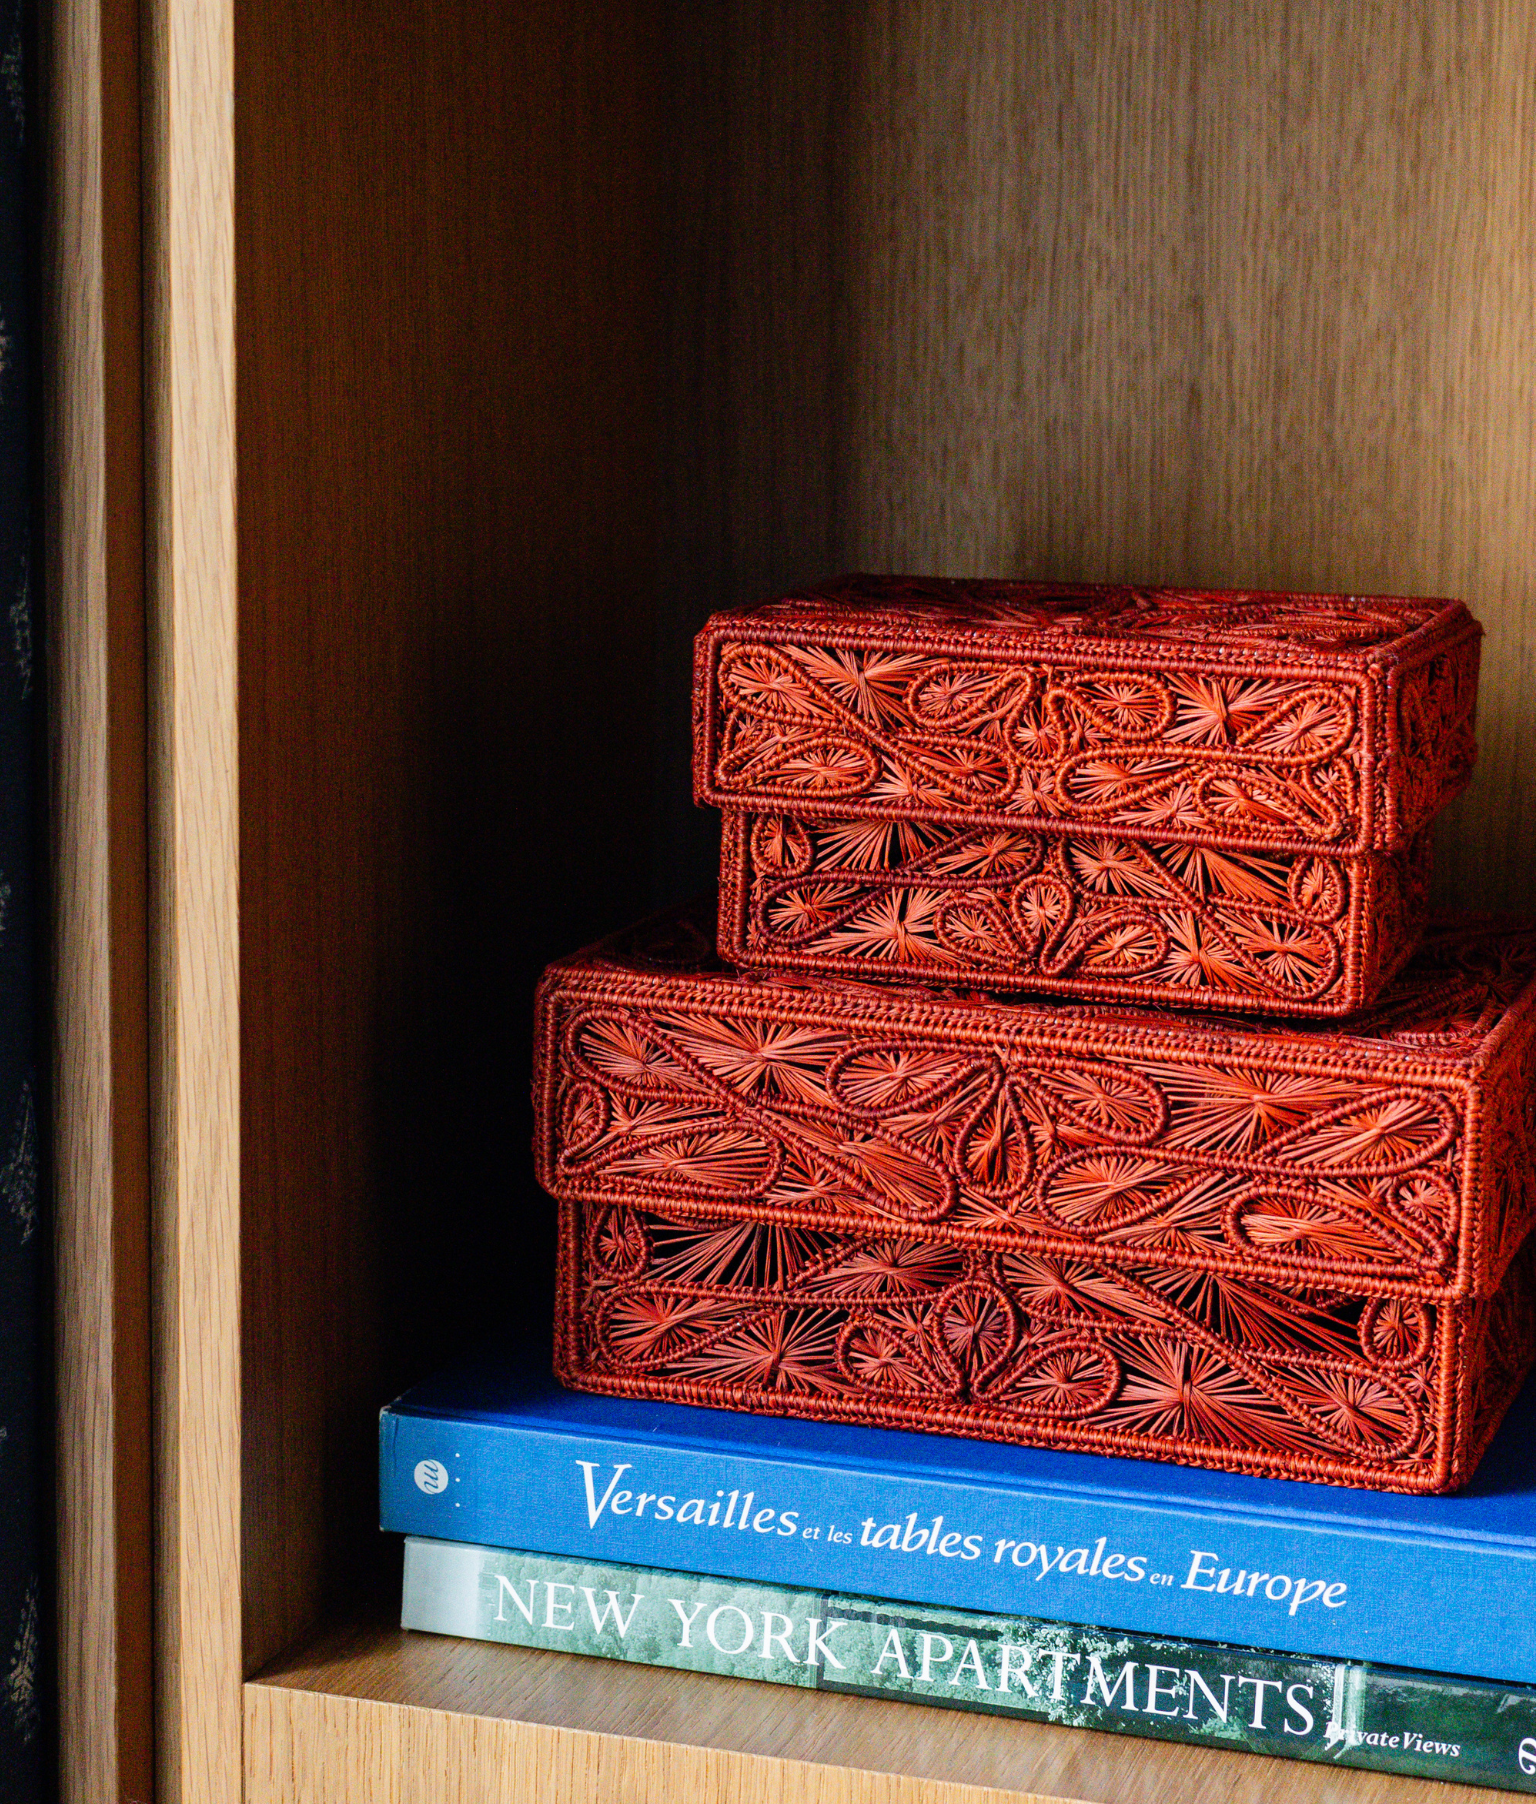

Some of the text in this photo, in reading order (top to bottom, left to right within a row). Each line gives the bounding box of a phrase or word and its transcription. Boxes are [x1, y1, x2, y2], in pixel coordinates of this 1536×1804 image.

[575, 1459, 1348, 1617] Versailles et les tables royales en Europe
[493, 1574, 1314, 1735] NEW YORK APARTMENTS
[1402, 1731, 1462, 1758] Views
